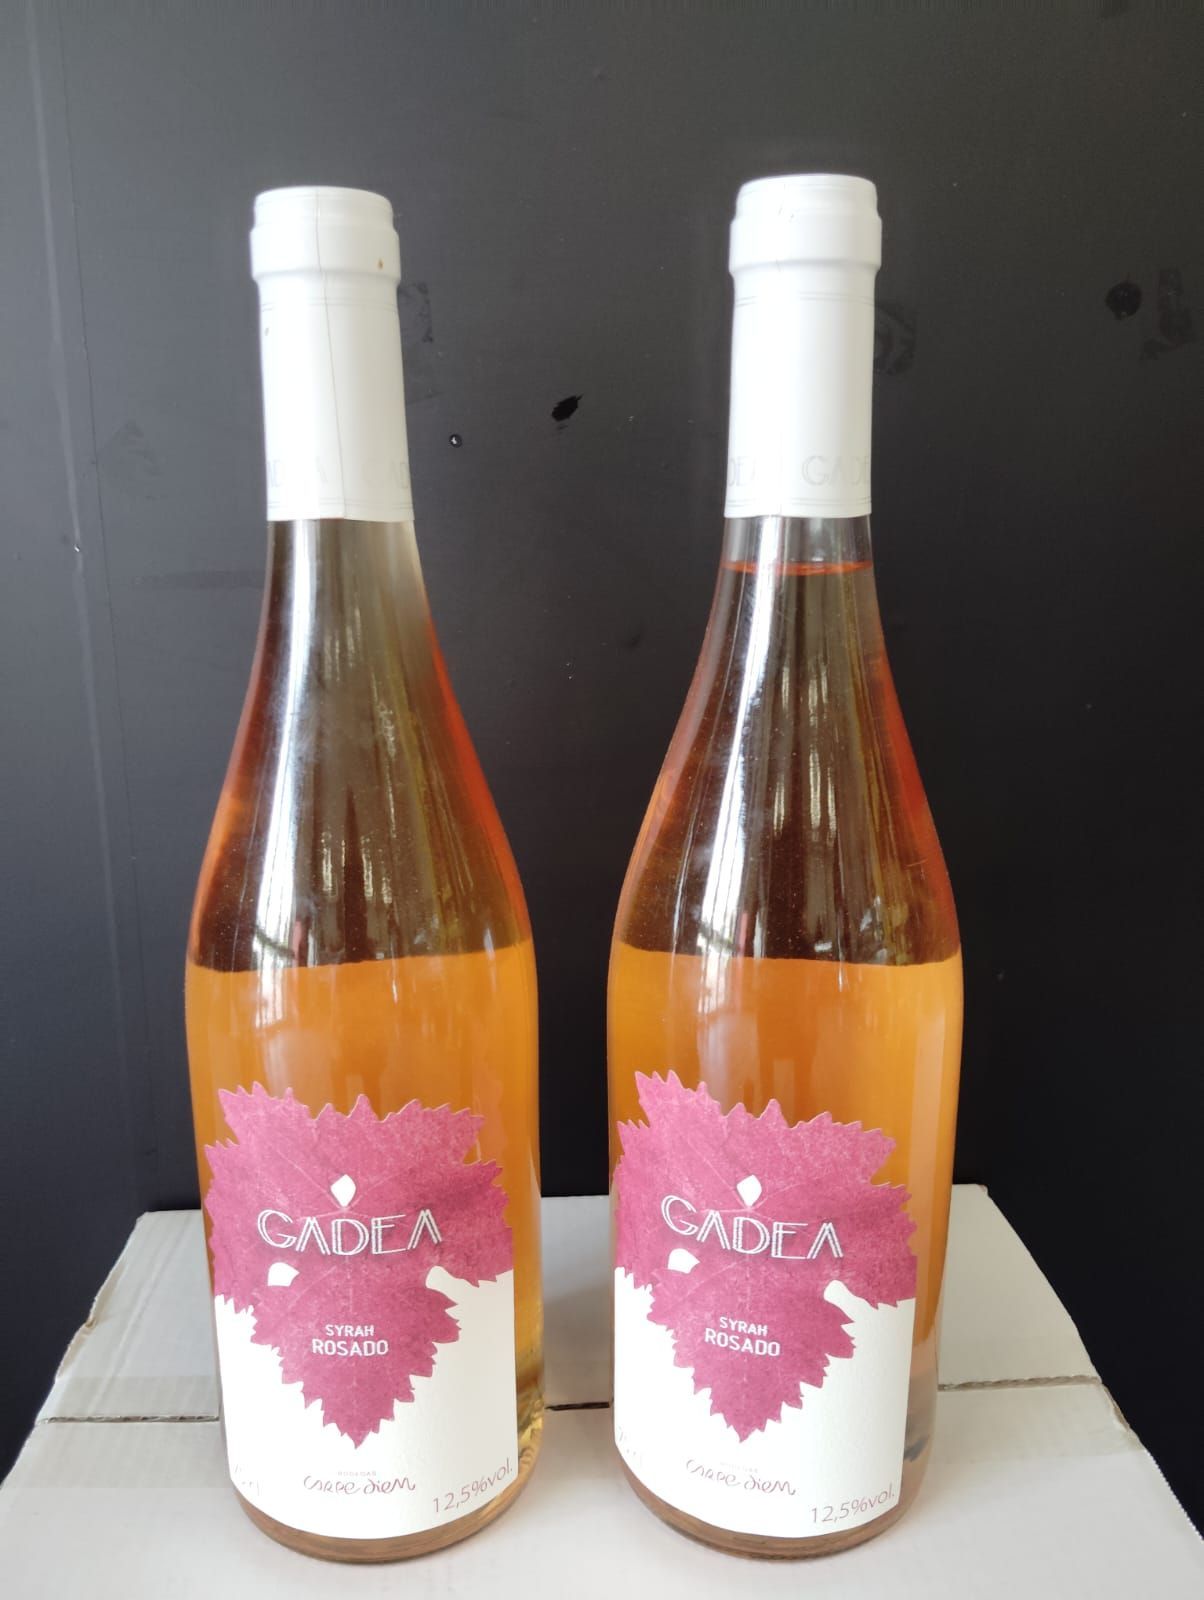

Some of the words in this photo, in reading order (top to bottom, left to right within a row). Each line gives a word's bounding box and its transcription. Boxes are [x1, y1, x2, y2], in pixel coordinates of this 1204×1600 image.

[257, 1209, 442, 1255] GADEA
[661, 1195, 844, 1260] GADEA
[325, 1324, 375, 1337] SYRAH
[719, 1316, 768, 1336] SYRAH
[311, 1338, 389, 1356] ROSADO
[704, 1328, 781, 1356] ROSADO
